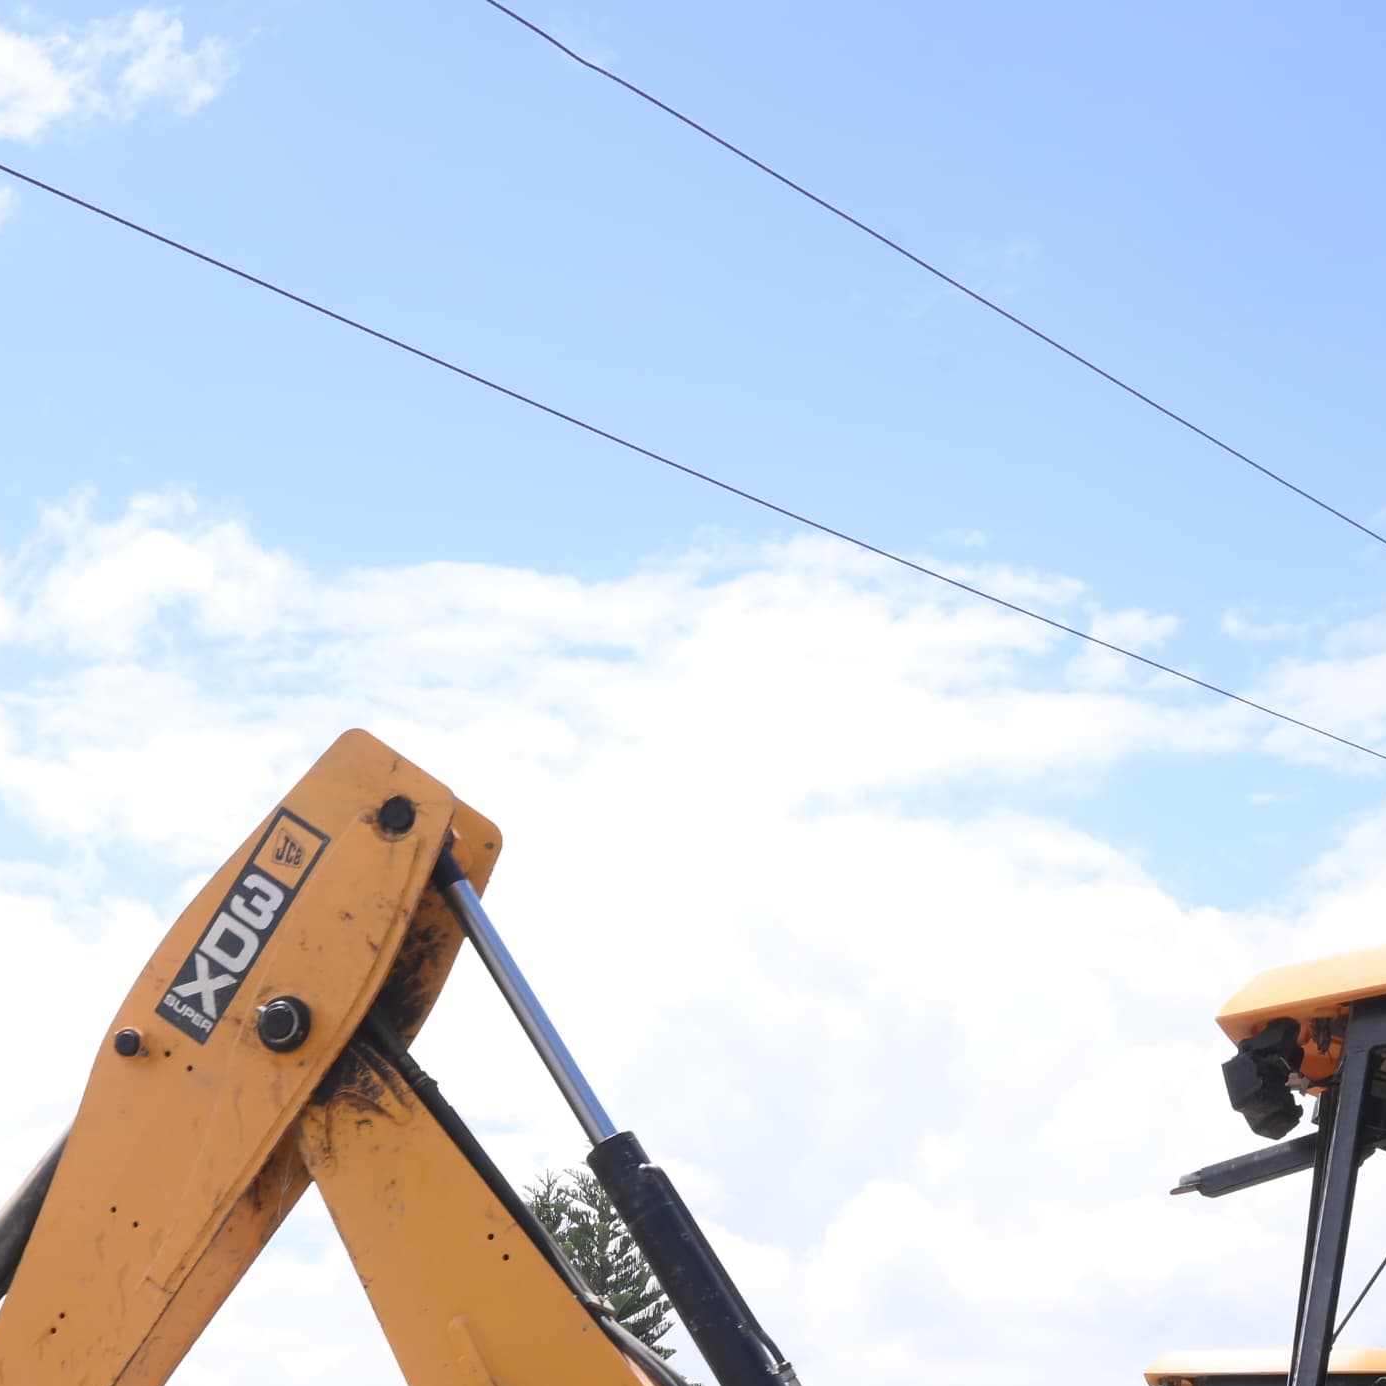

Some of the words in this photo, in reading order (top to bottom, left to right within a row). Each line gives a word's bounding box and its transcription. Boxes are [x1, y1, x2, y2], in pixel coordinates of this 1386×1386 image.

[275, 834, 303, 867] JCB
[172, 874, 285, 1020] 3DX
[163, 994, 215, 1034] SUPER
